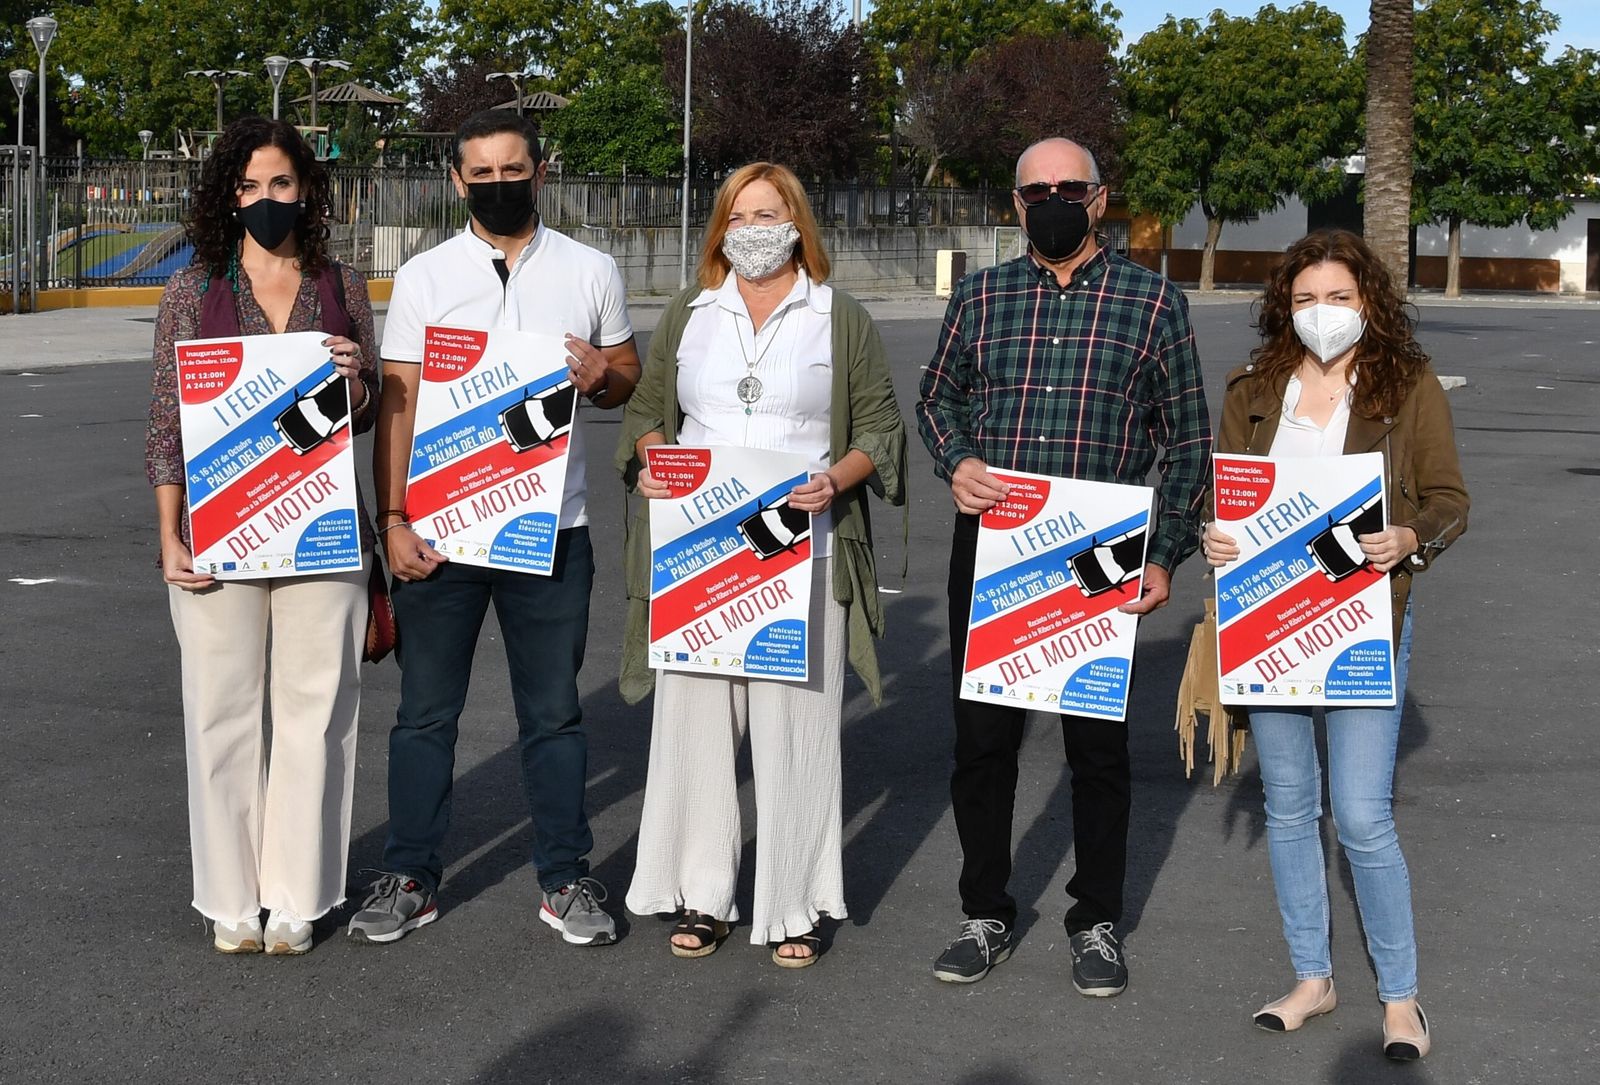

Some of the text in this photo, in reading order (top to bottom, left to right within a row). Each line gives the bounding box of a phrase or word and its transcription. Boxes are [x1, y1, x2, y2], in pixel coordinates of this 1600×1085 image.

[187, 348, 230, 357] Inauguración:
[434, 331, 475, 341] Inauguración:
[442, 354, 467, 362] 12:00H
[436, 362, 456, 370] 24:00
[449, 362, 519, 408] I FERIA
[214, 368, 286, 426] I FERIA
[190, 438, 252, 484] 15, 16 y 17 de Octubre
[207, 435, 275, 489] PALMA DEL RÍO
[415, 448, 425, 458] 15,
[424, 444, 432, 453] 16
[438, 438, 444, 447] 17
[445, 436, 453, 444] de
[453, 425, 476, 440] Octubre
[429, 426, 496, 467] PALMA DEL RÍO
[1222, 465, 1263, 474] Inauguración:
[226, 472, 339, 560] DEL MOTOR
[432, 472, 547, 539] DEL MOTOR
[681, 476, 751, 525] I FERIA
[1002, 502, 1028, 510] 12:00H
[1245, 491, 1319, 546] I FERIA
[655, 563, 666, 572] 15,
[665, 558, 673, 567] 16
[678, 551, 685, 560] 17
[686, 548, 694, 556] de
[693, 536, 717, 552] Octubre
[1011, 511, 1086, 556] I FERIA
[670, 536, 738, 580] PALMA DEL RÍO
[976, 570, 1043, 602] 15, 16 y 17 de Octubre
[992, 570, 1065, 612] PALMA DEL RÍO
[1220, 560, 1284, 602] 15, 16 y 17 de Octubre
[1237, 558, 1308, 609] PALMA DEL RÍO
[681, 579, 794, 653] DEL MOTOR
[998, 618, 1118, 685] DEL MOTOR
[1254, 600, 1373, 683] DEL MOTOR
